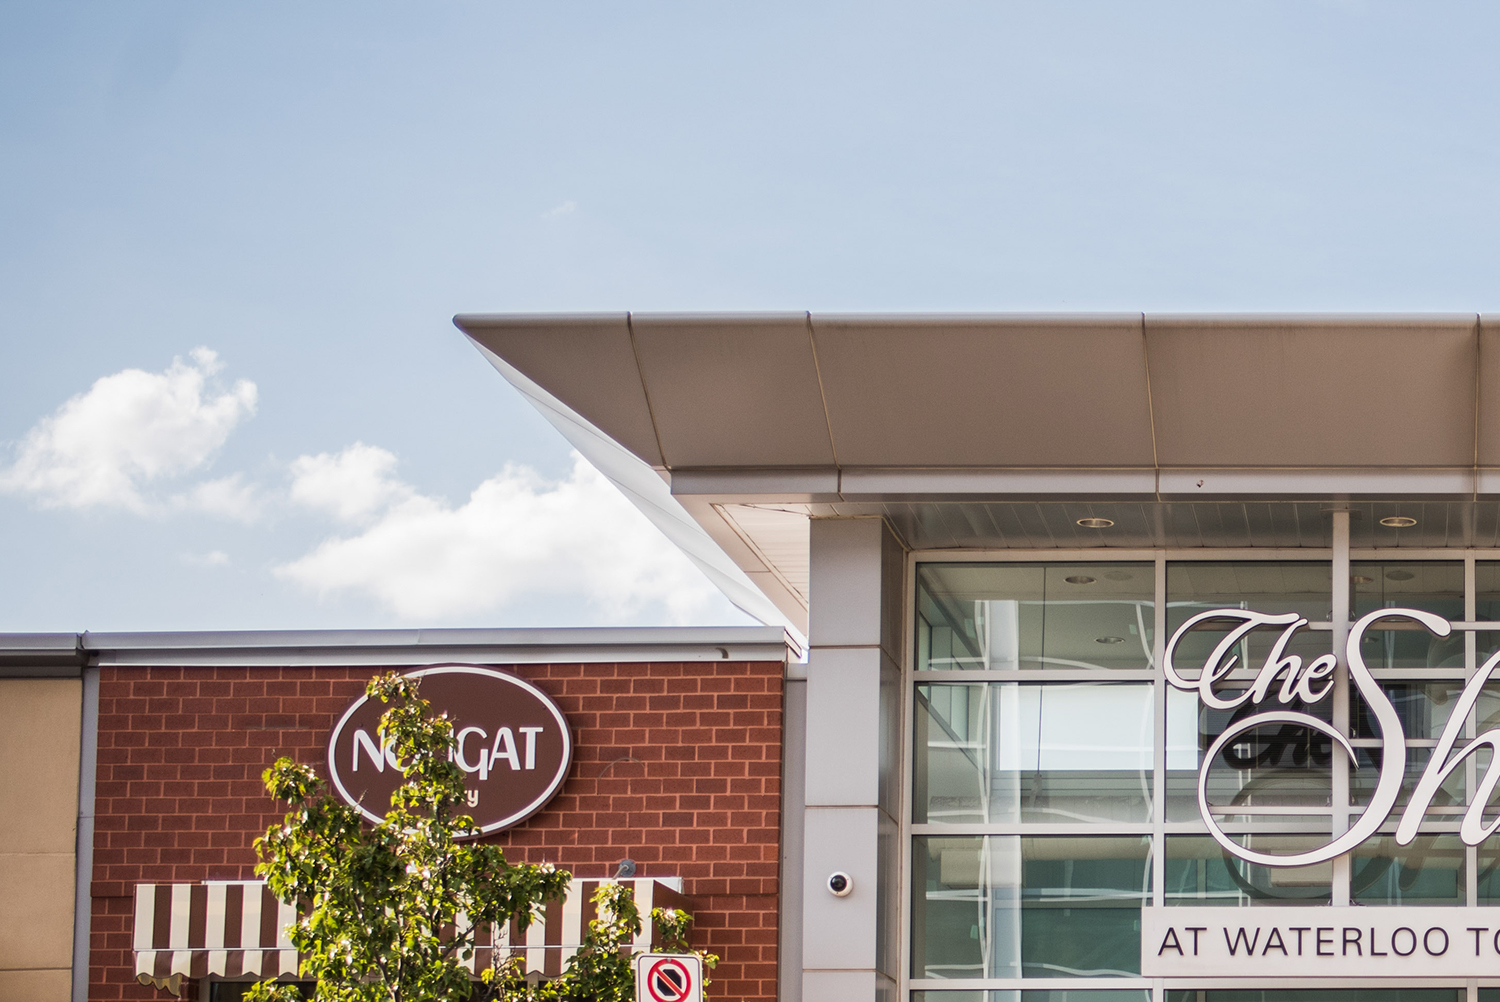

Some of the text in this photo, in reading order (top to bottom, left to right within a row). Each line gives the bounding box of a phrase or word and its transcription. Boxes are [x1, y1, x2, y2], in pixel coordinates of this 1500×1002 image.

[1163, 608, 1337, 711] The
[352, 726, 544, 781] NOGAT
[1157, 928, 1208, 957] AT
[1224, 927, 1450, 957] WATERLOO
